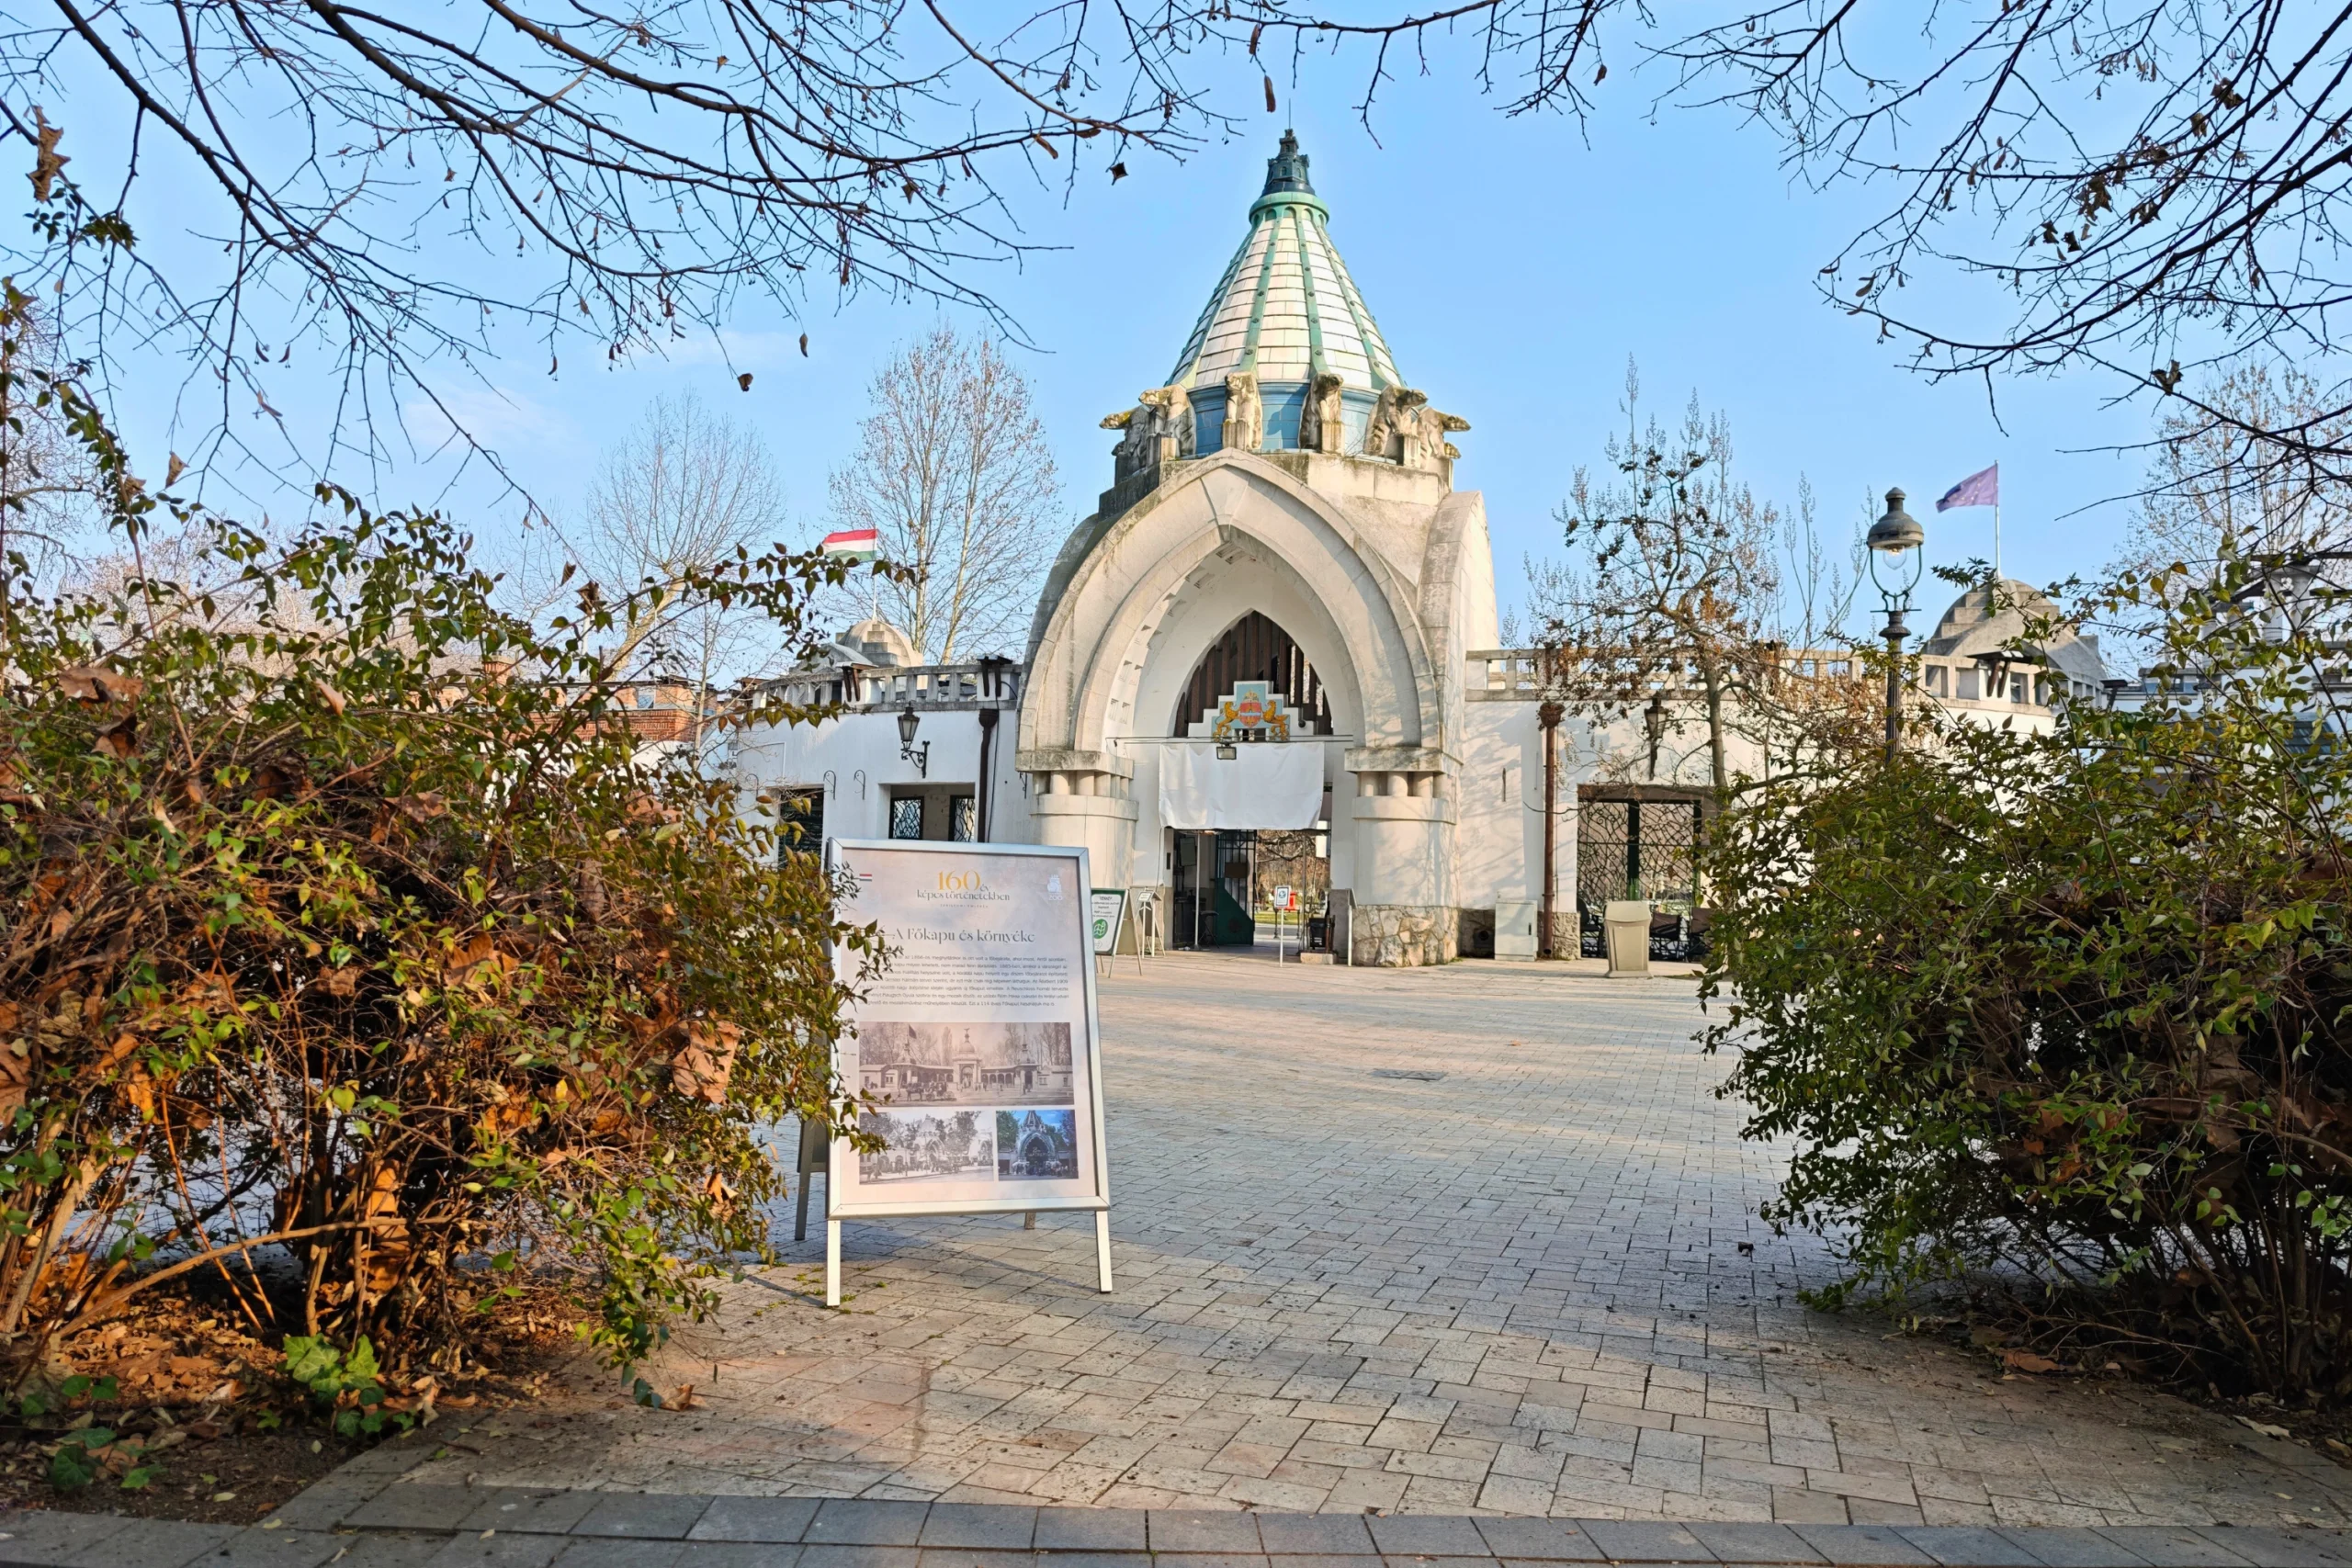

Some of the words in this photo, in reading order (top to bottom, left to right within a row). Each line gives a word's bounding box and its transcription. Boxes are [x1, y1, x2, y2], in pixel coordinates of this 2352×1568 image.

[937, 870, 980, 891] 160
[979, 884, 991, 892] év
[917, 889, 944, 901] képes
[945, 890, 1010, 901] történetekben
[893, 928, 904, 940] A
[908, 928, 956, 944] Főkapu
[958, 930, 974, 942] és
[977, 929, 1035, 942] környéke
